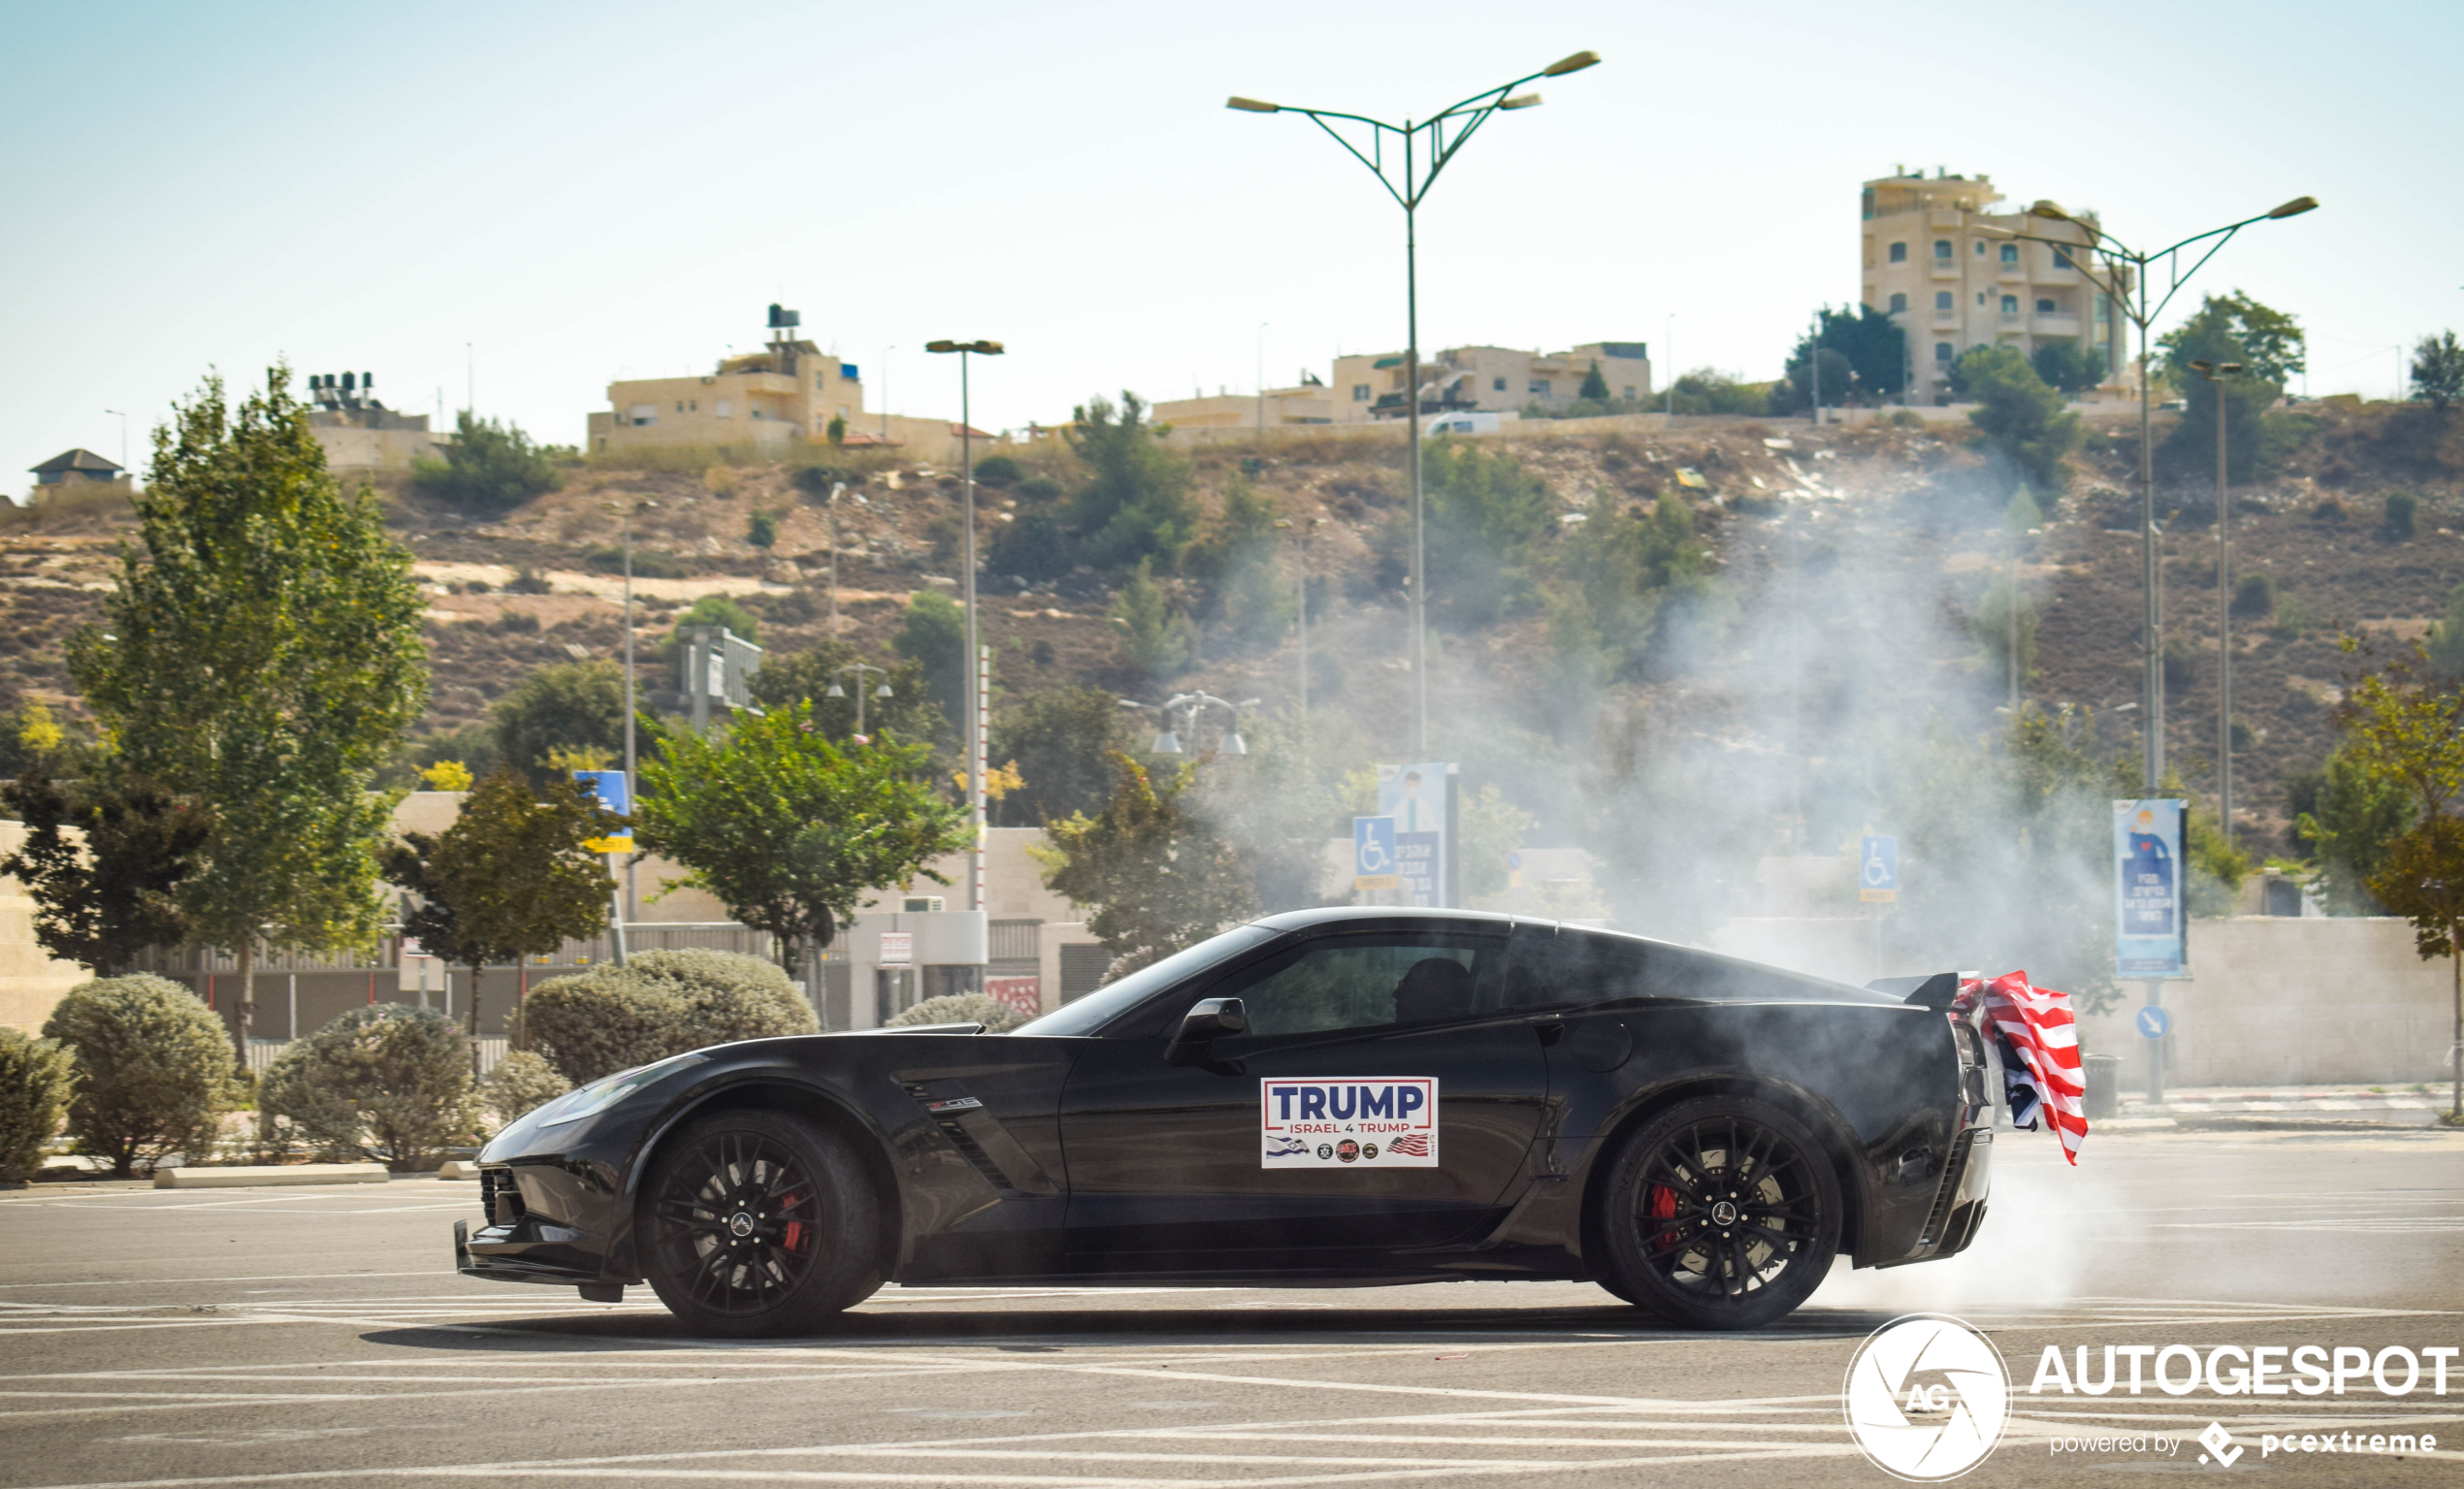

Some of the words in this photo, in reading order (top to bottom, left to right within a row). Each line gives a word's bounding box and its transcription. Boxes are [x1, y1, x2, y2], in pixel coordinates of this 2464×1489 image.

[1272, 1085, 1424, 1120] TRUMP
[1289, 1123, 1341, 1134] ISRAEL
[1345, 1123, 1354, 1133] 4
[1358, 1122, 1410, 1133] TRUMP
